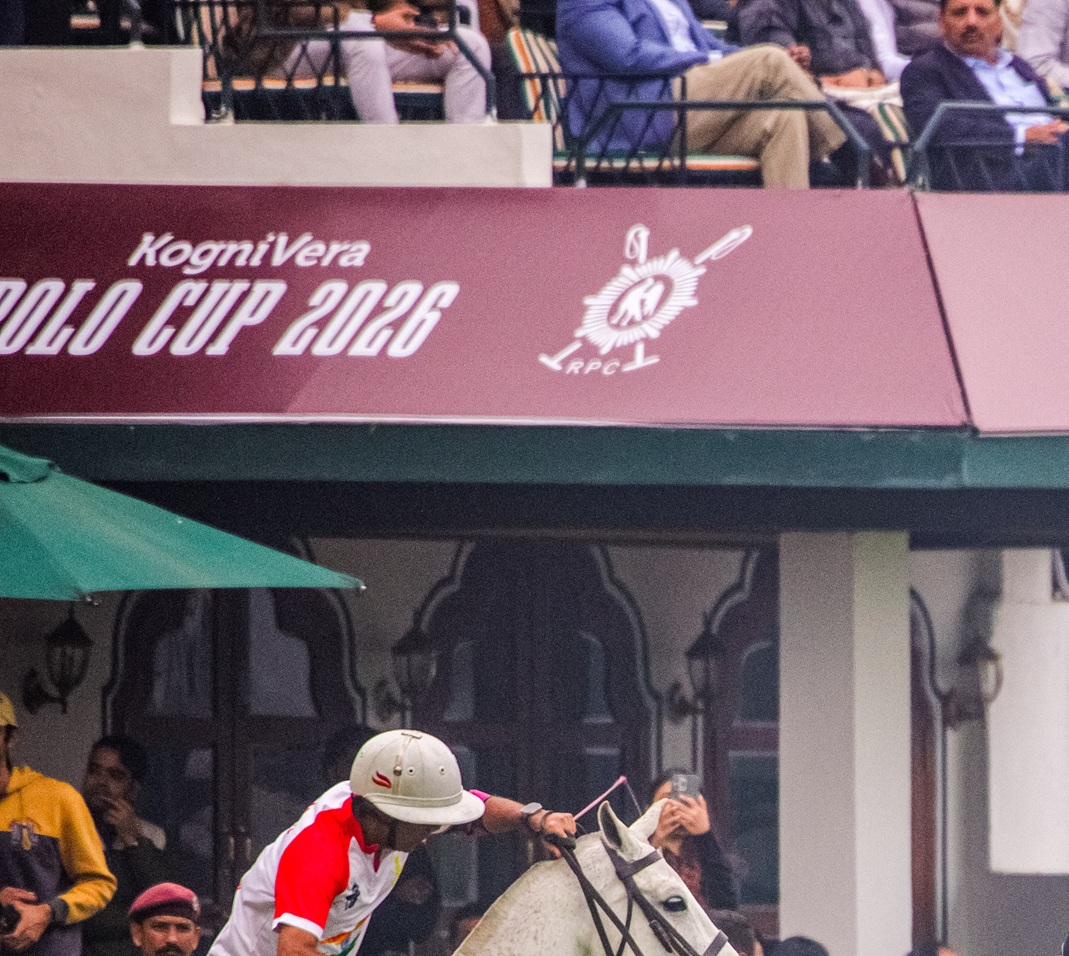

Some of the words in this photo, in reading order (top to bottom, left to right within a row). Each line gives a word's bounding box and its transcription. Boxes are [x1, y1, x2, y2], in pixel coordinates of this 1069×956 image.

[128, 232, 371, 275] KogniVera
[132, 279, 288, 355] CUP
[273, 279, 460, 357] 2026
[565, 358, 620, 376] RPC
